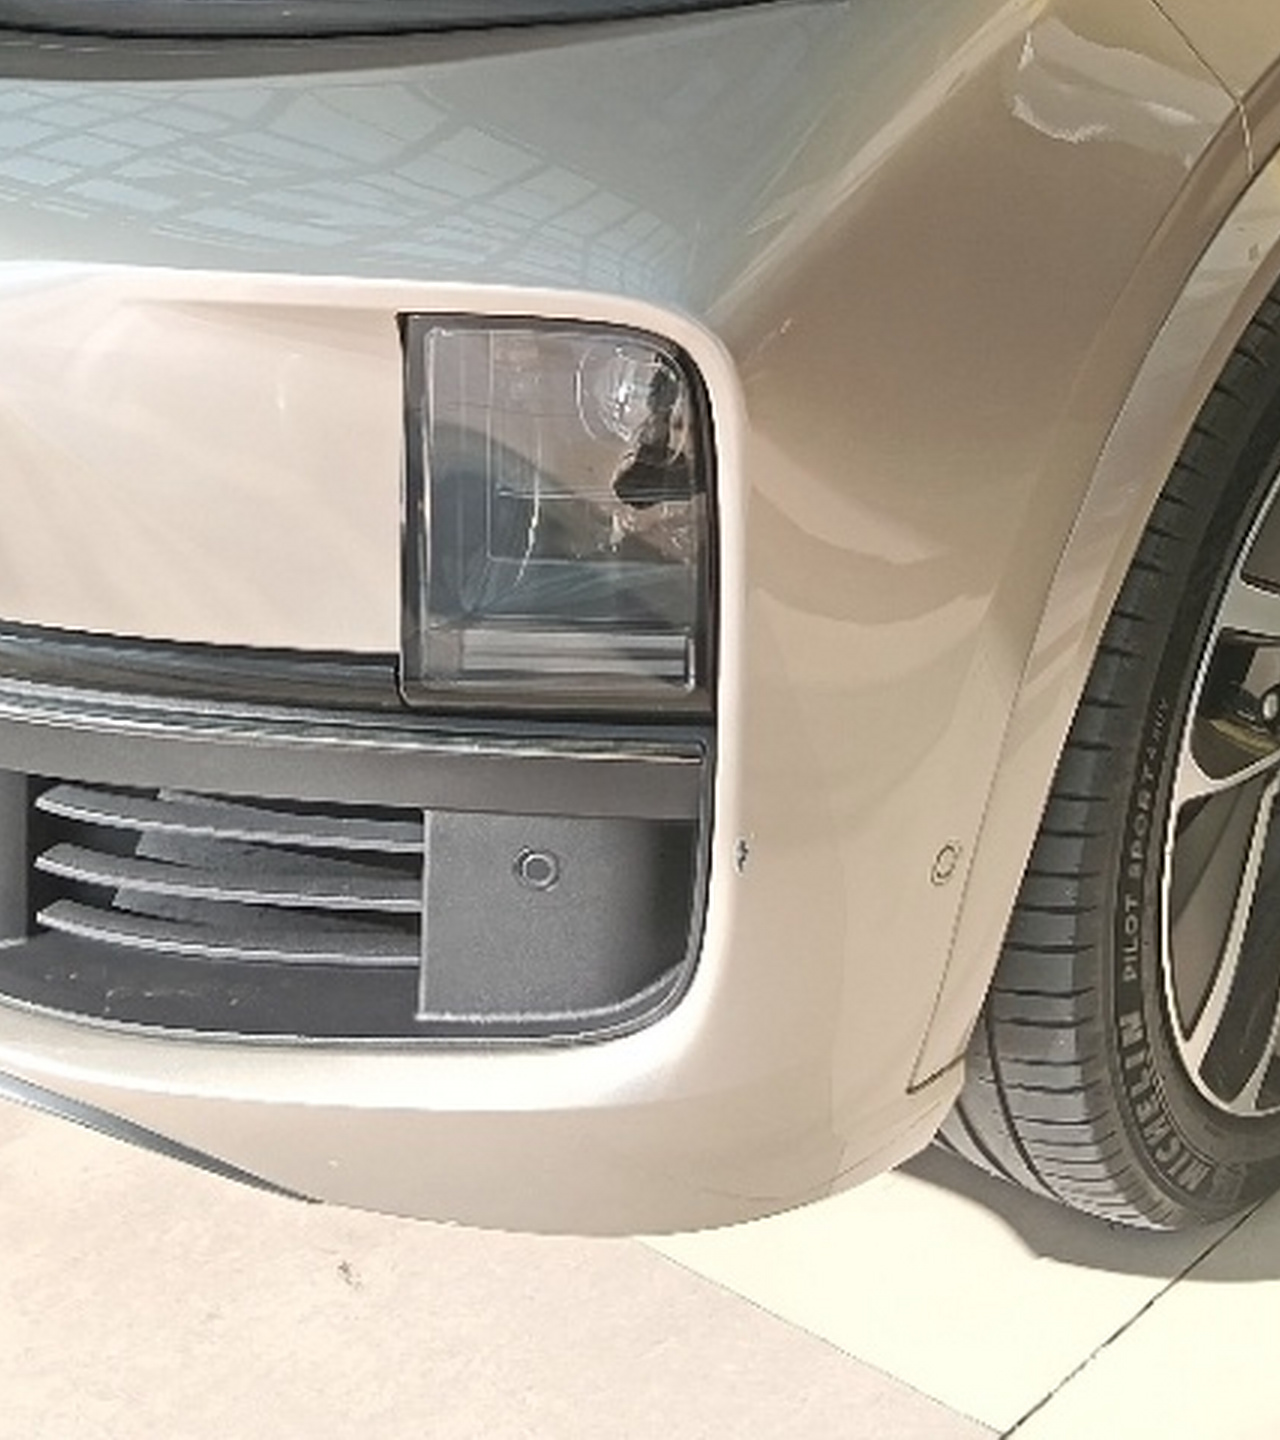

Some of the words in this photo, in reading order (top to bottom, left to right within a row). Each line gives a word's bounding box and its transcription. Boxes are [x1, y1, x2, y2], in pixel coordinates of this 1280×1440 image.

[1128, 761, 1155, 878] SPORT
[1121, 894, 1141, 982] PILOT
[1119, 1009, 1212, 1193] MICHELIN
